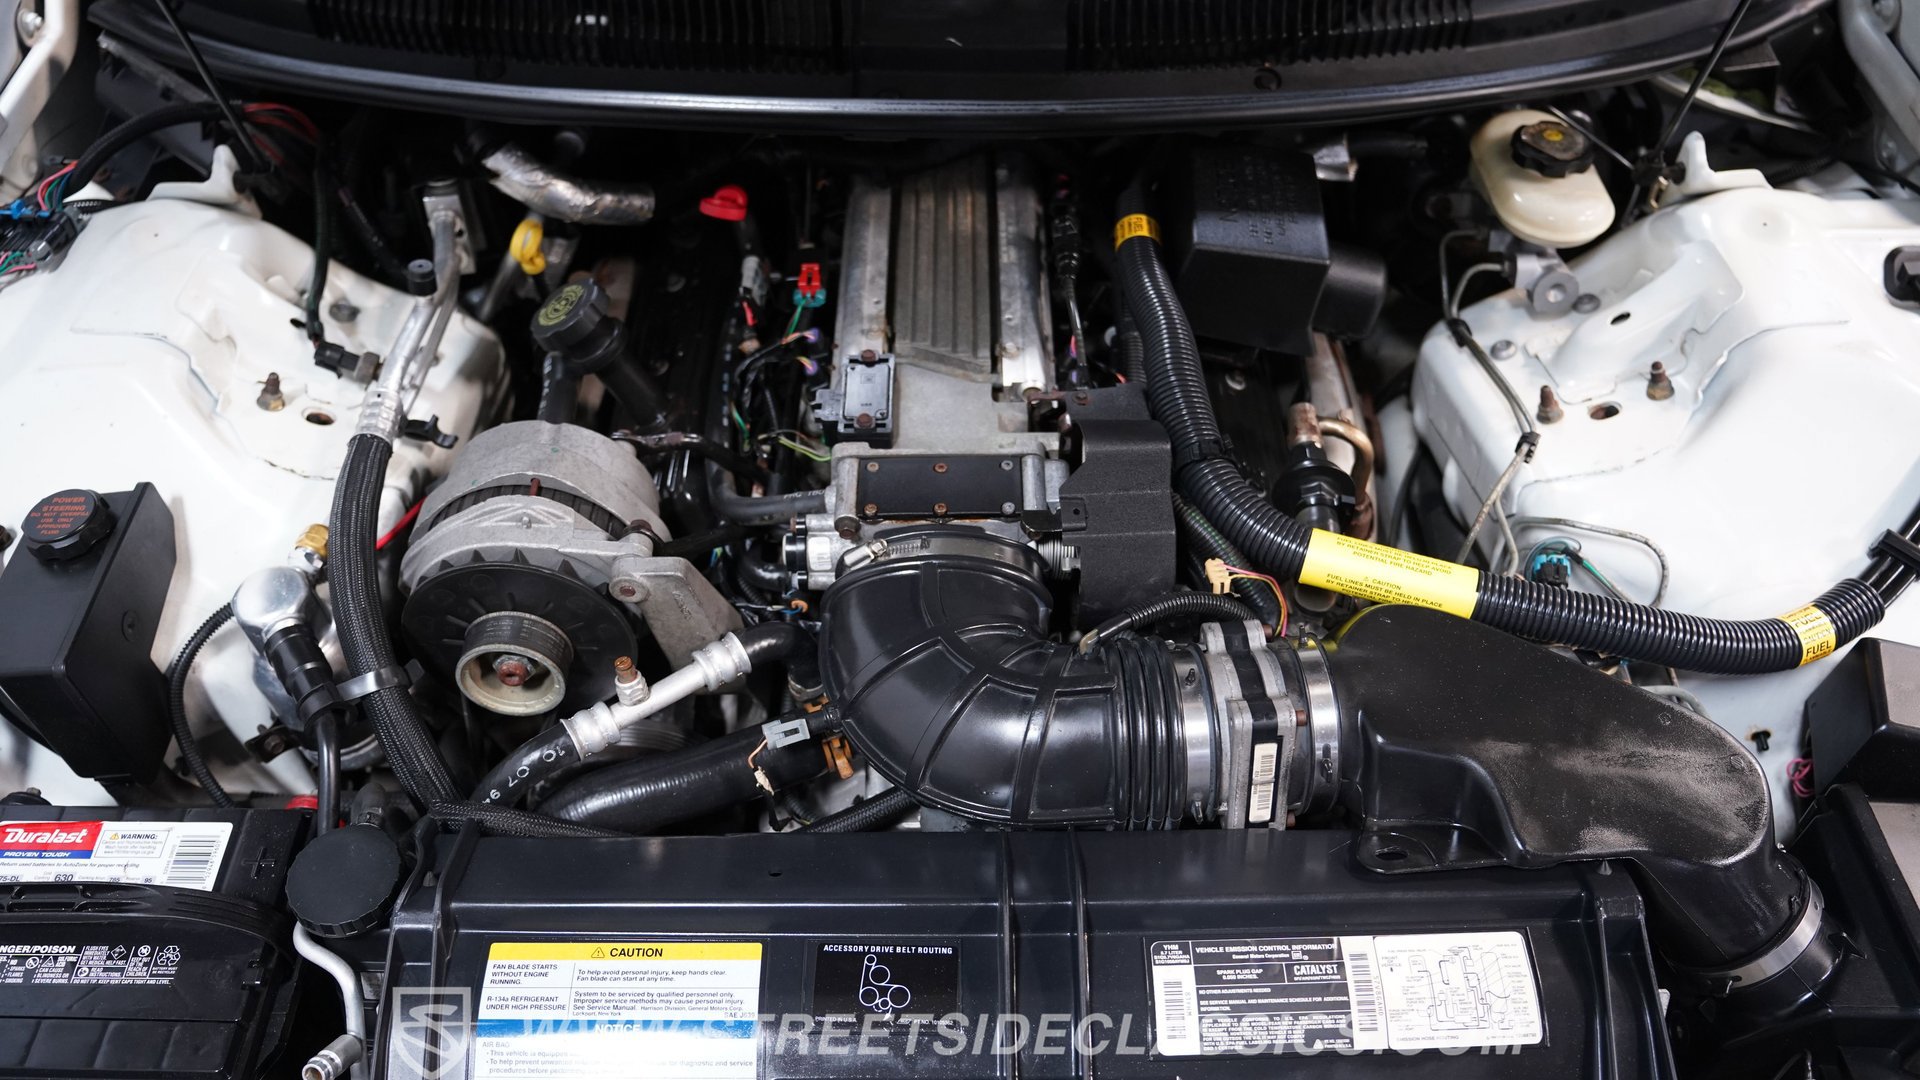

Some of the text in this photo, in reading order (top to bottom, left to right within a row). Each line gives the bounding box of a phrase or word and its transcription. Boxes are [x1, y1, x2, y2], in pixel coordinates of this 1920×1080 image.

[1353, 551, 1387, 565] POTENTIAL
[1372, 578, 1402, 590] CAUTION
[1327, 573, 1343, 582] FUEL
[1344, 578, 1363, 587] LINES
[1365, 583, 1383, 592] MUST
[1394, 591, 1412, 600] HELD
[1421, 599, 1444, 608] PLACE
[1336, 582, 1368, 593] RETAINER
[1369, 590, 1391, 599] STRAP
[1806, 640, 1832, 657] FUEL
[4, 828, 88, 844] Duralast
[54, 873, 74, 882] 630
[610, 947, 663, 958] CAUTION
[823, 944, 953, 954] ACCESSORY DRIVE BELT ROUTING
[1195, 943, 1336, 954] VEHICLE EMISSION CONTROL INFORMATION
[587, 969, 601, 977] help
[621, 969, 649, 977] personal
[650, 969, 670, 977] injury,
[672, 969, 687, 977] keep
[1293, 964, 1338, 975] CATALYST
[594, 1024, 641, 1034] NOTICE
[499, 1059, 513, 1067] help
